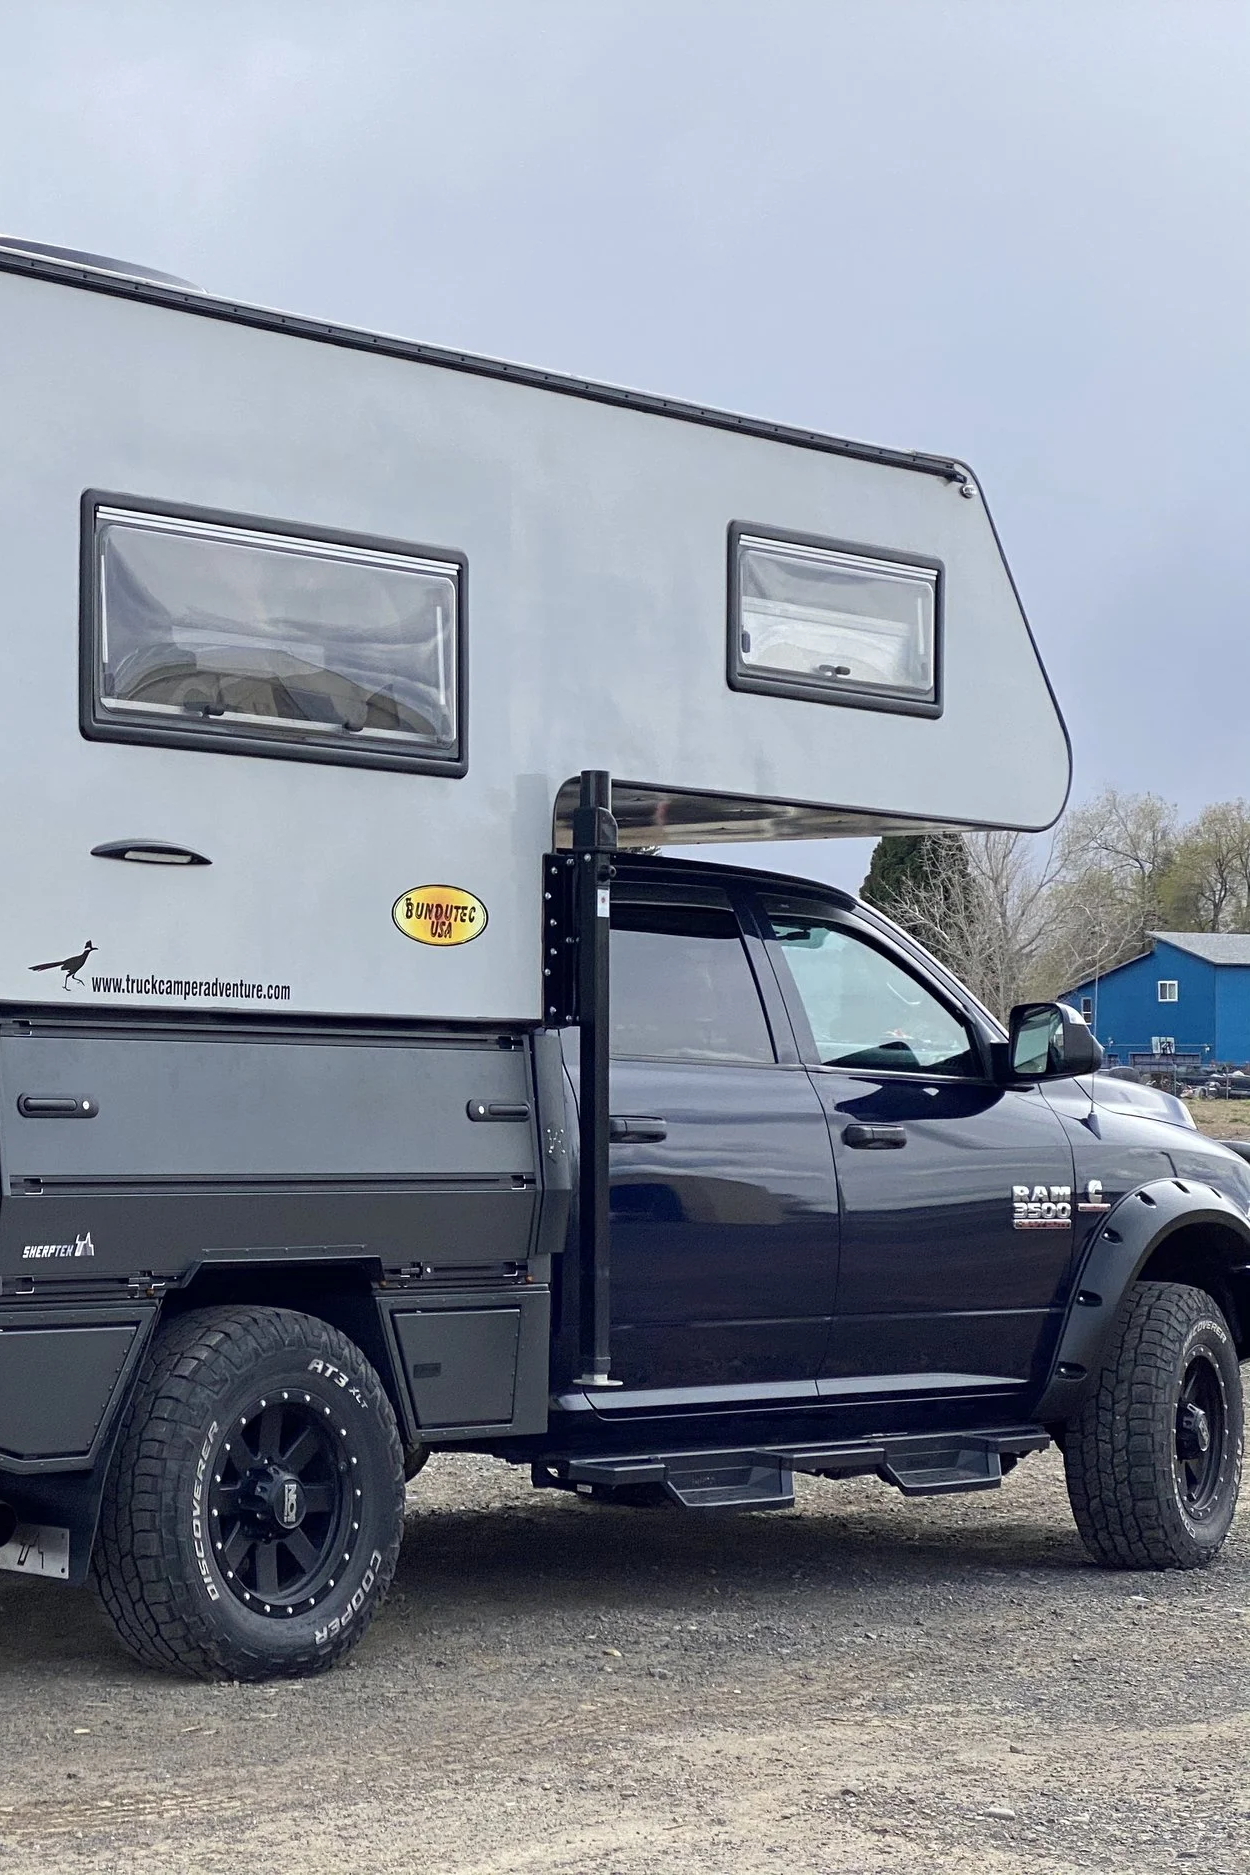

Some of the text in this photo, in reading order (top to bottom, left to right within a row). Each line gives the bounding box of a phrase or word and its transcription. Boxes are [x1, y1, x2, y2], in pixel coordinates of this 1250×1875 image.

[405, 897, 477, 923] BUNDUTEC
[430, 921, 453, 938] USA
[91, 974, 291, 1000] www.truckcamperadventure.com
[1012, 1185, 1071, 1202] RAM
[1013, 1202, 1072, 1219] 3500
[22, 1245, 75, 1258] SHERPTEK
[307, 1358, 368, 1408] AT3 XLT
[192, 1420, 220, 1601] DISCOVERER
[314, 1549, 382, 1645] COOPER
